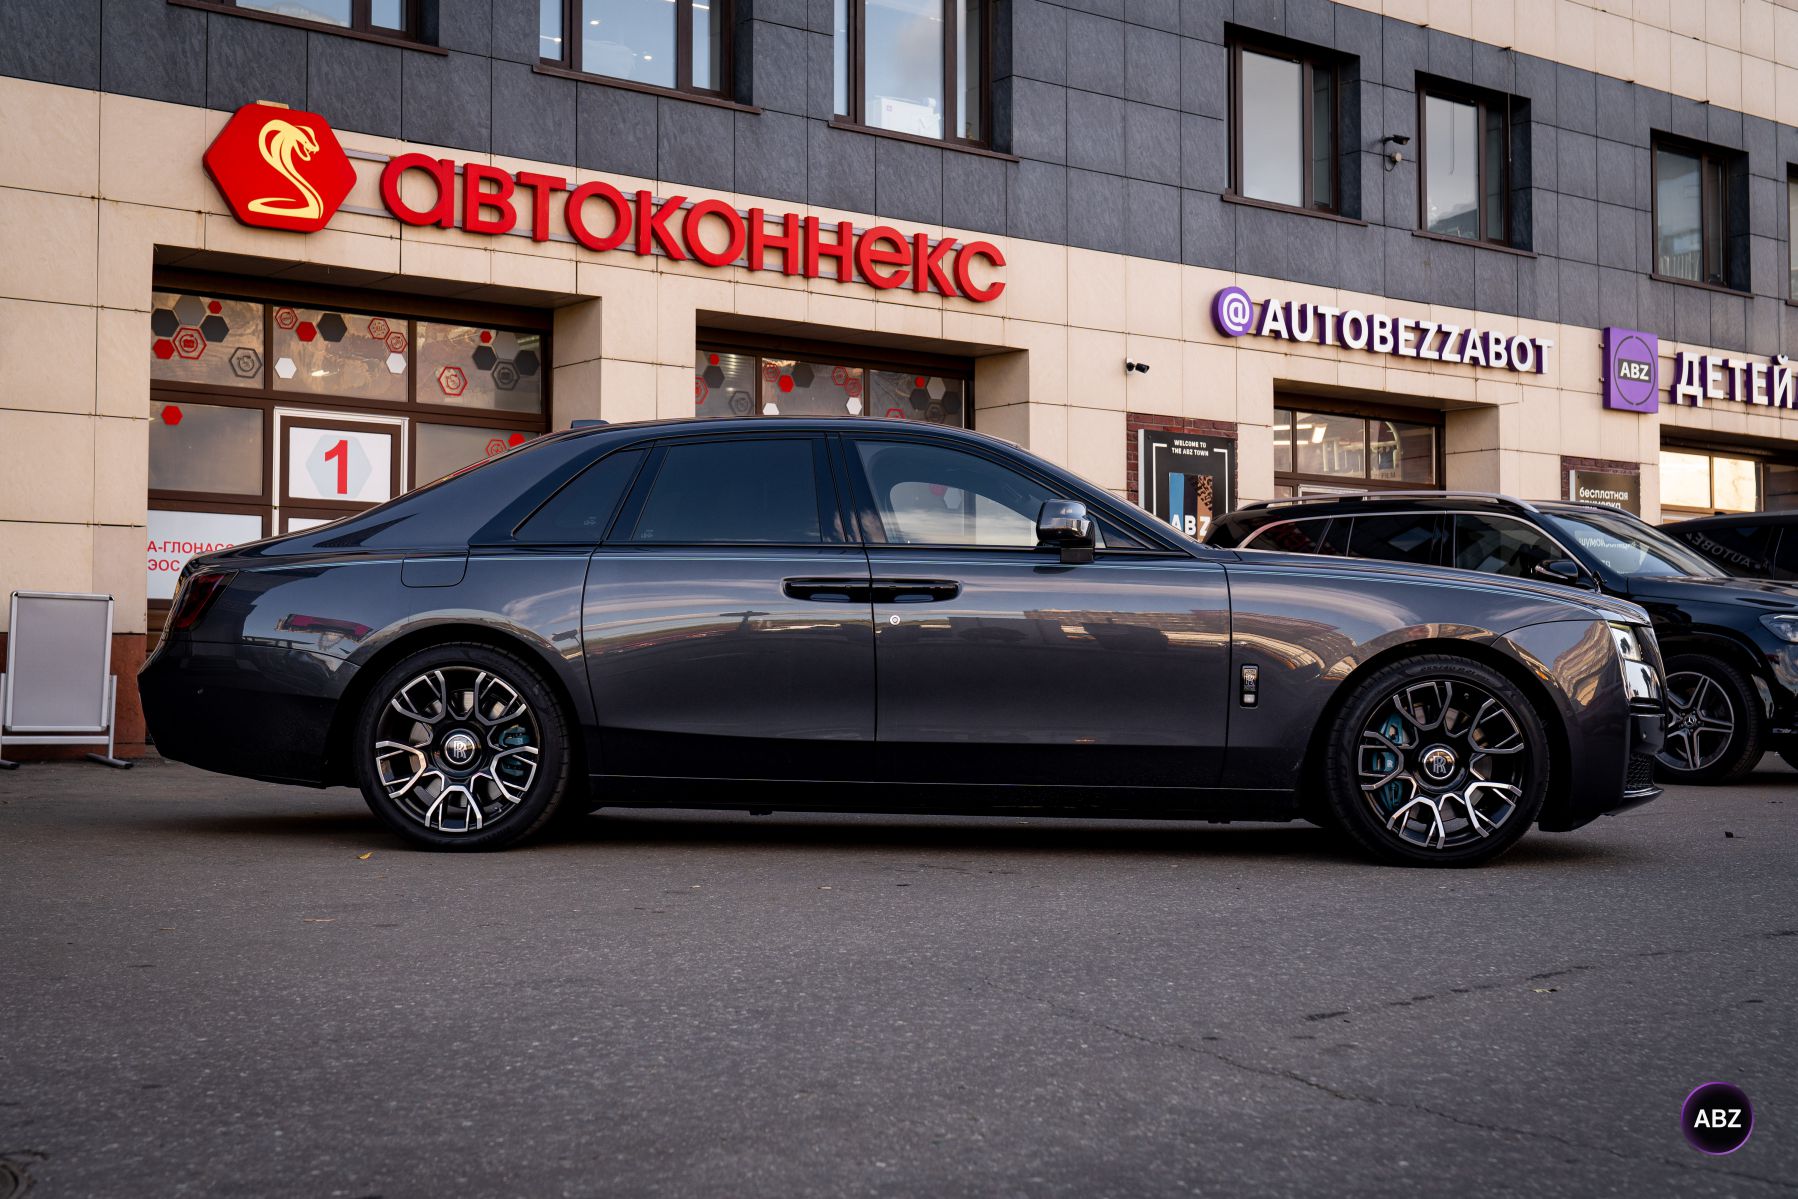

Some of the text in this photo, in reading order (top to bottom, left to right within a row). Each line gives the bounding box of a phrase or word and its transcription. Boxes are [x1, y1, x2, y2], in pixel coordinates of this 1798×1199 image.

[1619, 361, 1650, 381] ABZ
[1671, 352, 1798, 409] ДЕТЕЙ
[1172, 447, 1209, 457] THE ABZ TOWN
[1174, 439, 1207, 449] WELCOME TO
[325, 439, 348, 495] 1
[1579, 486, 1629, 501] бесплатная
[1171, 513, 1212, 536] ABZ
[147, 558, 180, 572] ЭОС
